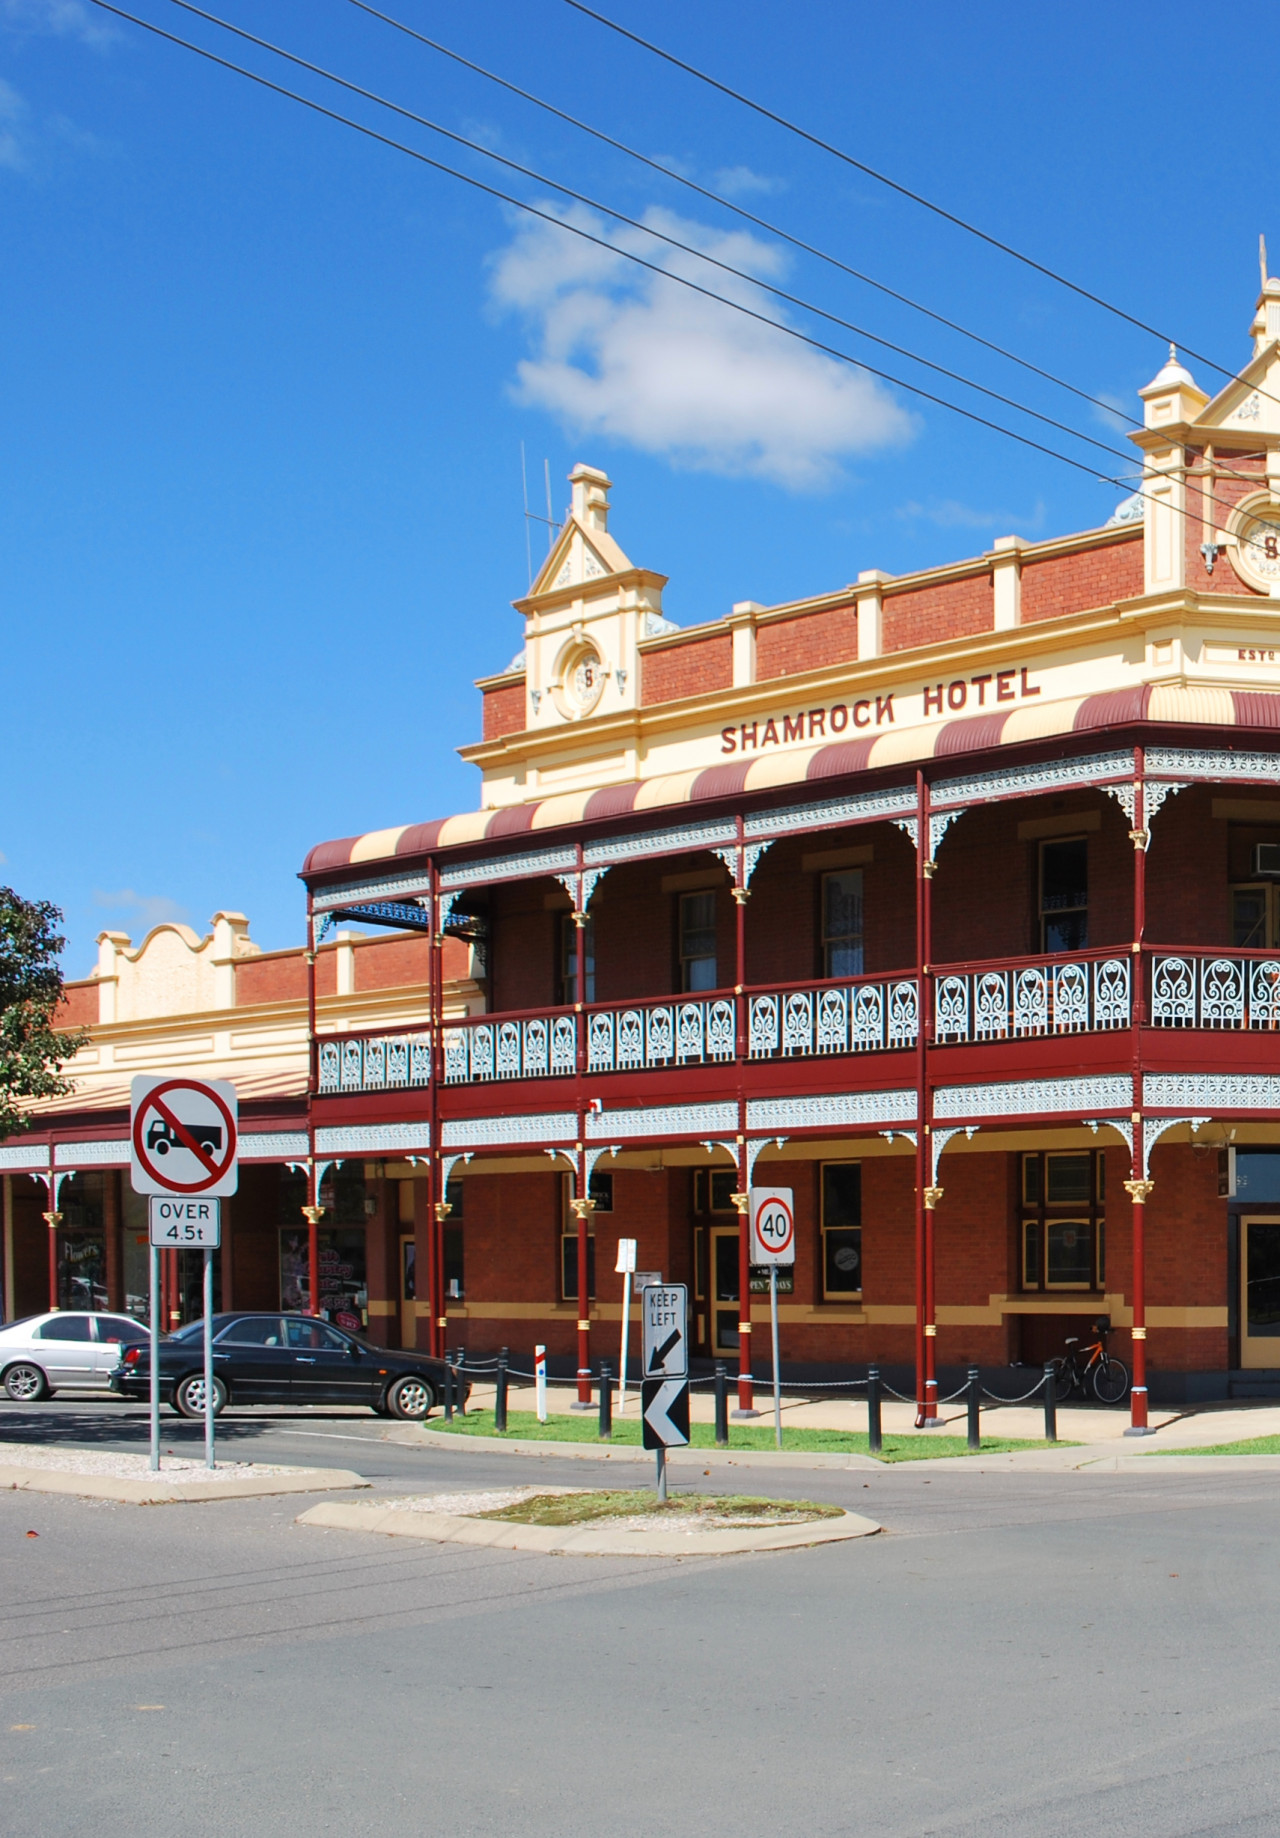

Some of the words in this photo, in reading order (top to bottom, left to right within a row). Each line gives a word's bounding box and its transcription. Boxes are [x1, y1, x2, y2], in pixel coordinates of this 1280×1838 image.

[720, 693, 895, 754] SHAMROCK
[923, 667, 1041, 717] HOTEL
[160, 1203, 210, 1219] OVER
[166, 1225, 204, 1240] 4.5t
[762, 1213, 787, 1238] 40
[650, 1293, 678, 1307] KEEP
[651, 1313, 677, 1326] LEFT
